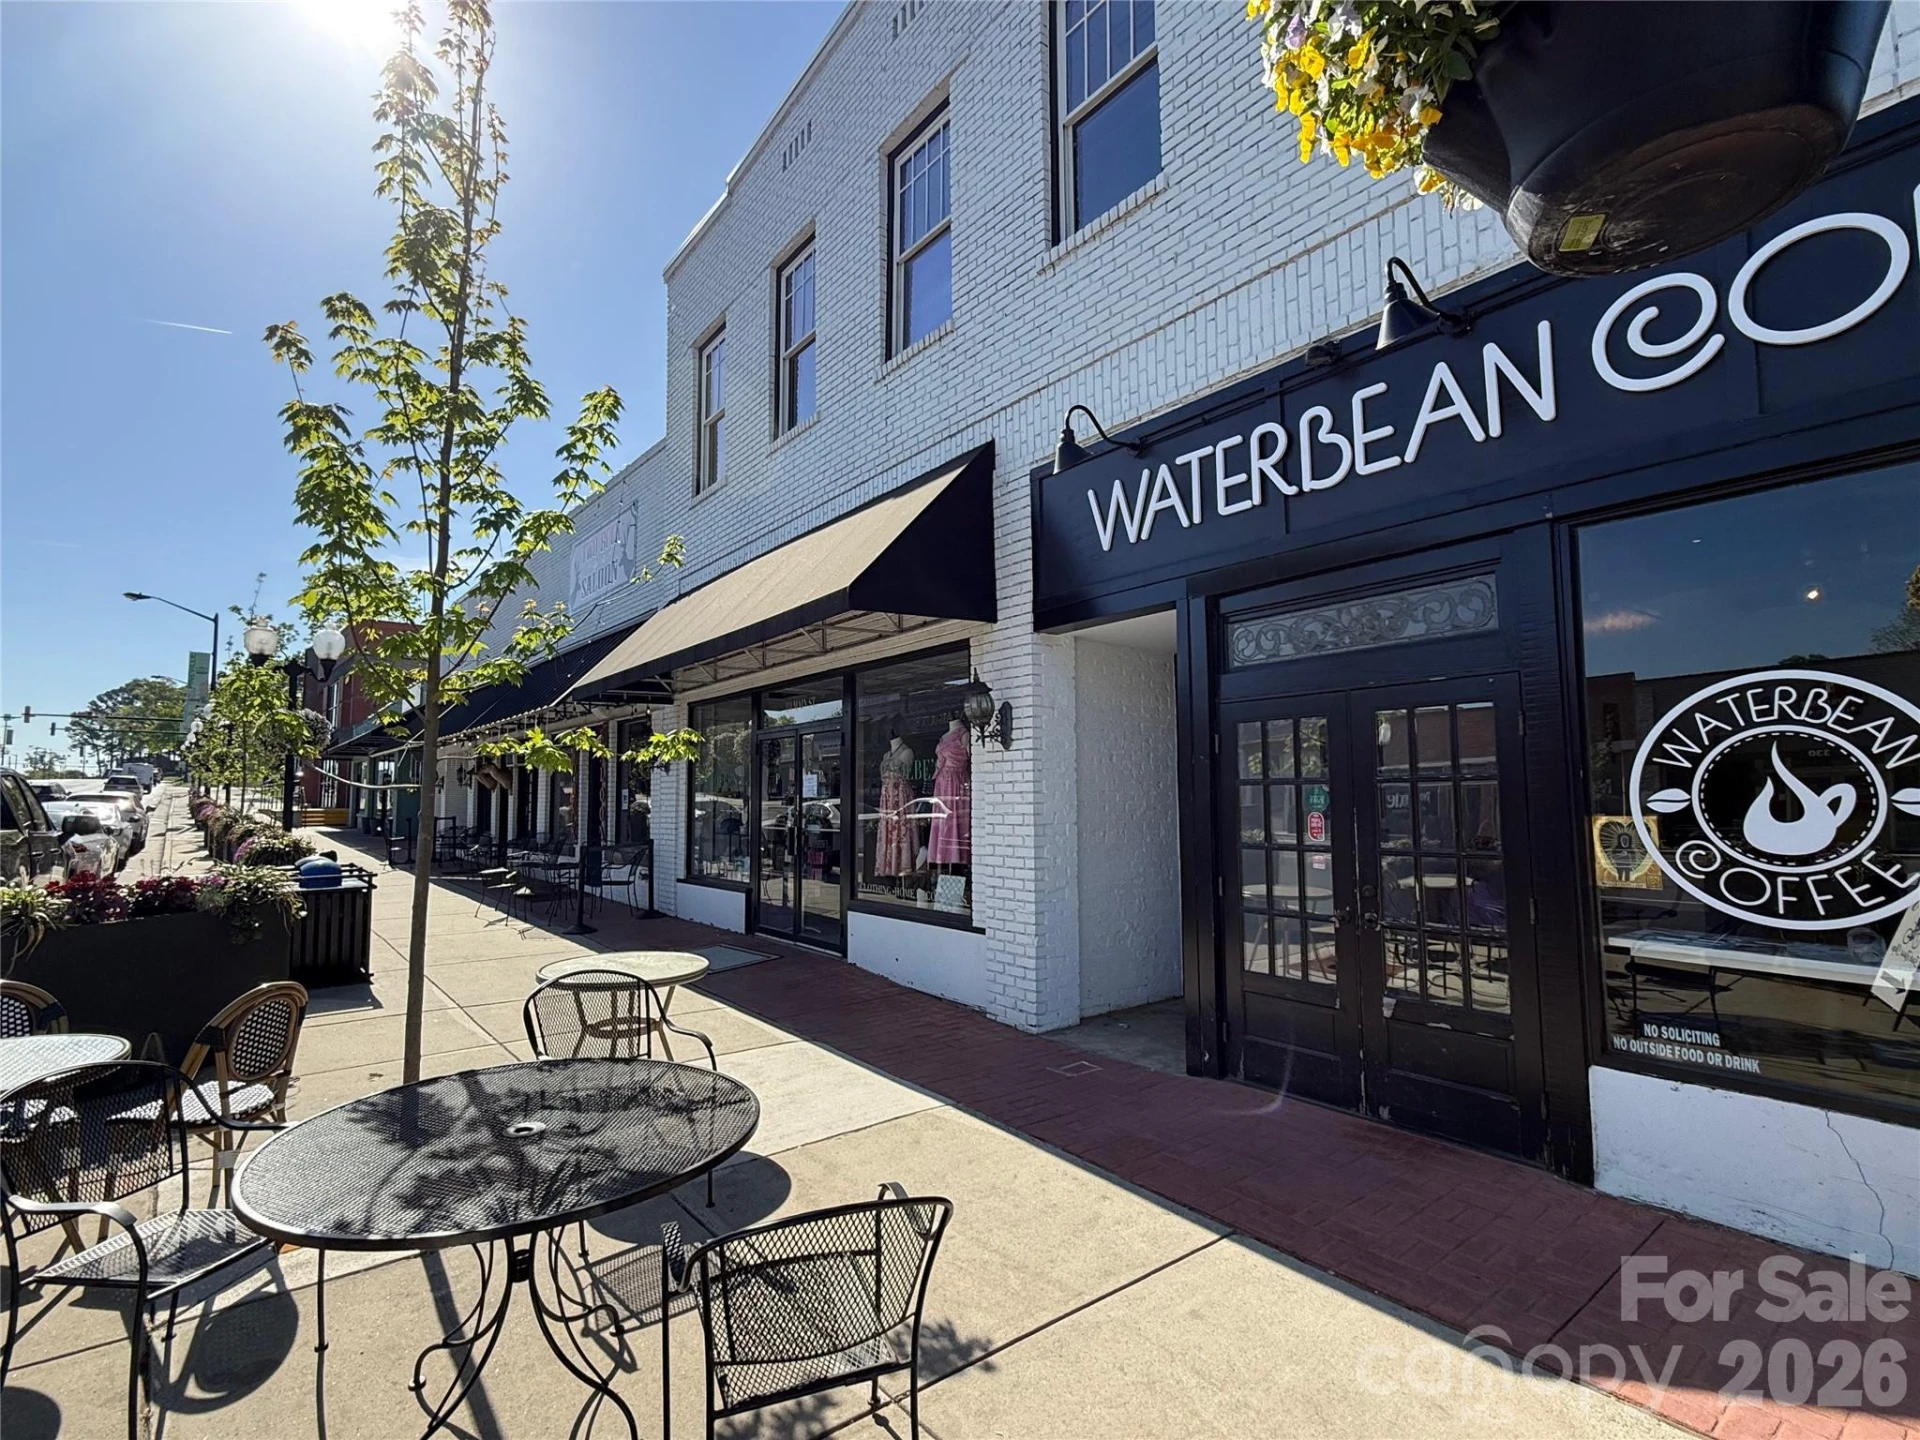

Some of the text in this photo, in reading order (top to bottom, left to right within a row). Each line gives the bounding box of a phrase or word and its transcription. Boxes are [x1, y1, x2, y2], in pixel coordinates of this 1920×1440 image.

[1086, 183, 1920, 553] WATERBEAN CO
[1652, 686, 1920, 769] WATERBEAN
[1675, 840, 1920, 915] COFFEE
[1613, 1036, 1760, 1073] NO OUTSIDE FOOD OR DRINK
[1643, 1023, 1720, 1047] NO SOLICITING
